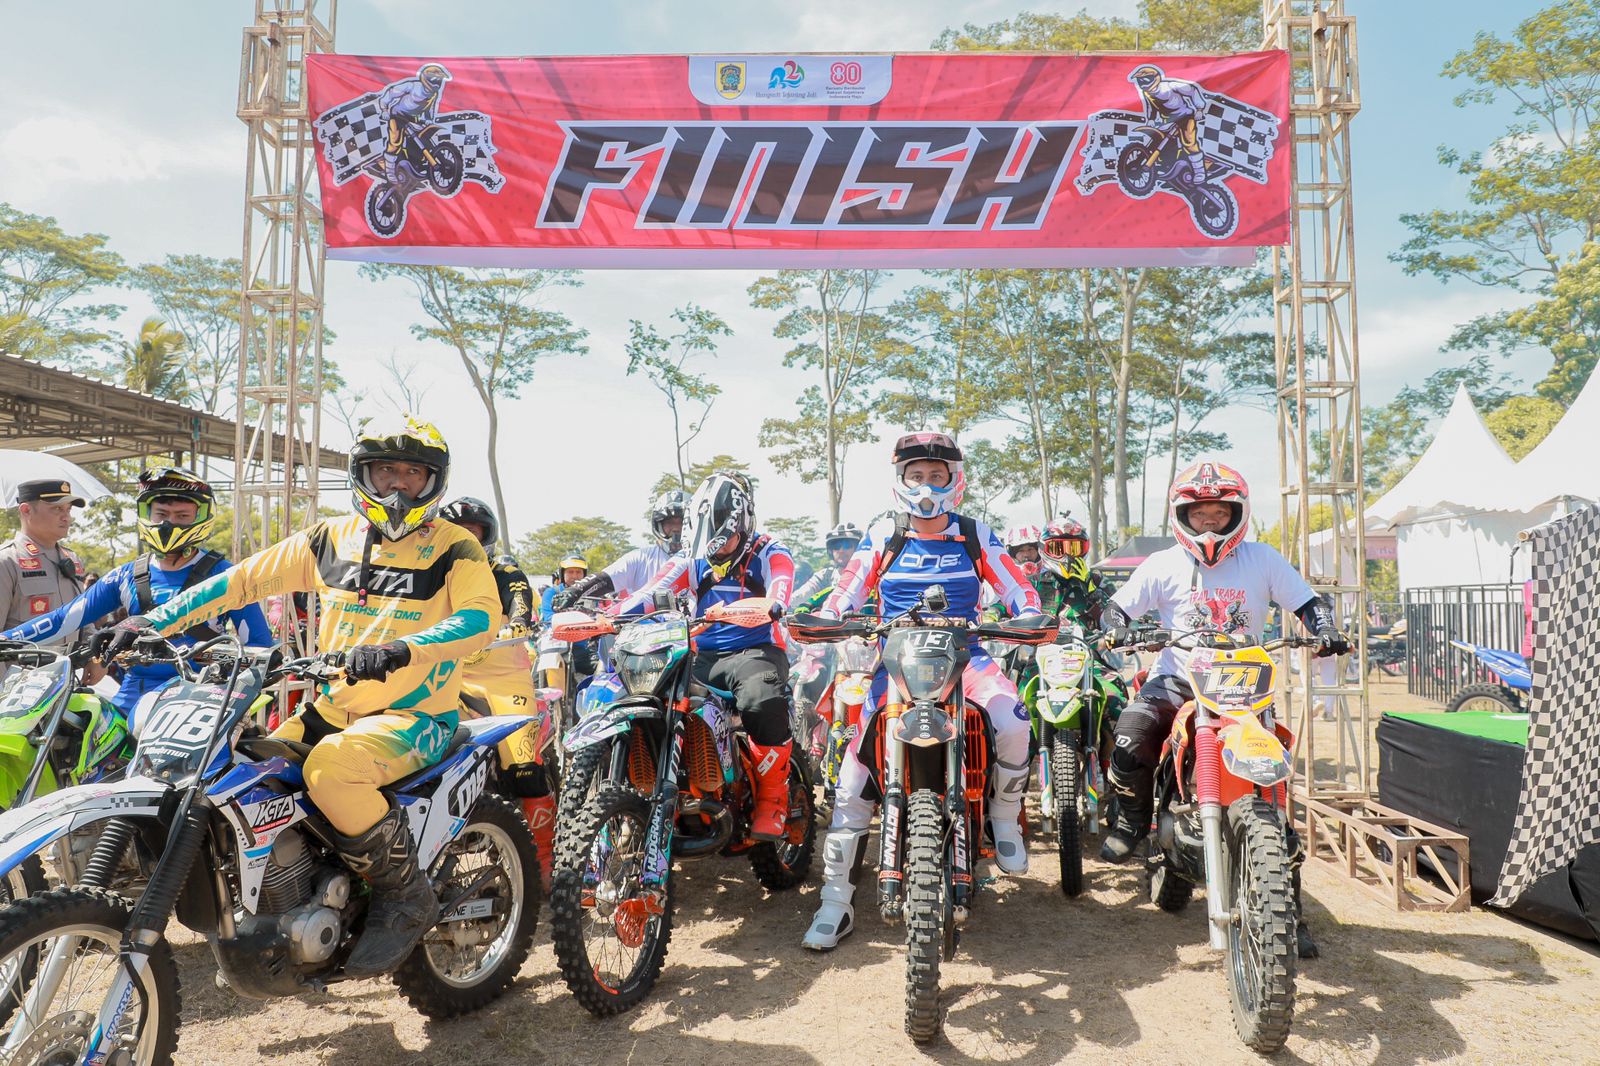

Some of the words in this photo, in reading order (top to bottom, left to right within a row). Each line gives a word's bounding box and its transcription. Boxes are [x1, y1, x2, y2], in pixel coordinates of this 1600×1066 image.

[830, 62, 861, 85] 80
[535, 120, 1088, 231] FINISH
[339, 566, 414, 594] KTA
[1203, 667, 1261, 694] 171
[513, 695, 528, 707] 27
[143, 703, 221, 743] 018
[757, 748, 780, 777] SIDI
[457, 760, 486, 818] 018
[254, 794, 294, 826] KTA
